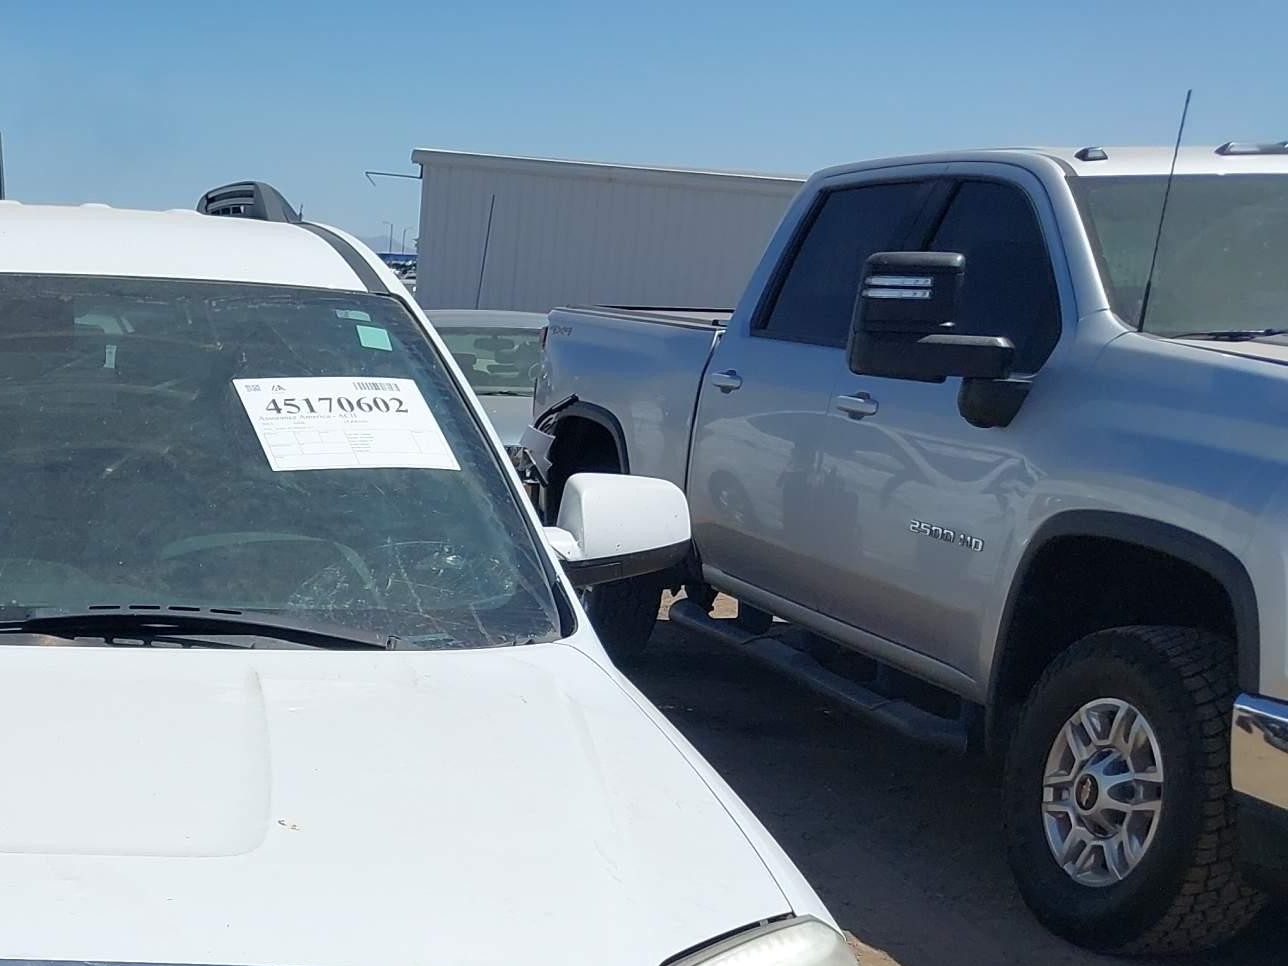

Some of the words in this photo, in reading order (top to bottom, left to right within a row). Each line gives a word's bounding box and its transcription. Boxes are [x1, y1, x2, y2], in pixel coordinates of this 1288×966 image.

[266, 396, 409, 414] 45170602
[909, 519, 955, 543] 2500
[958, 533, 984, 552] HD
